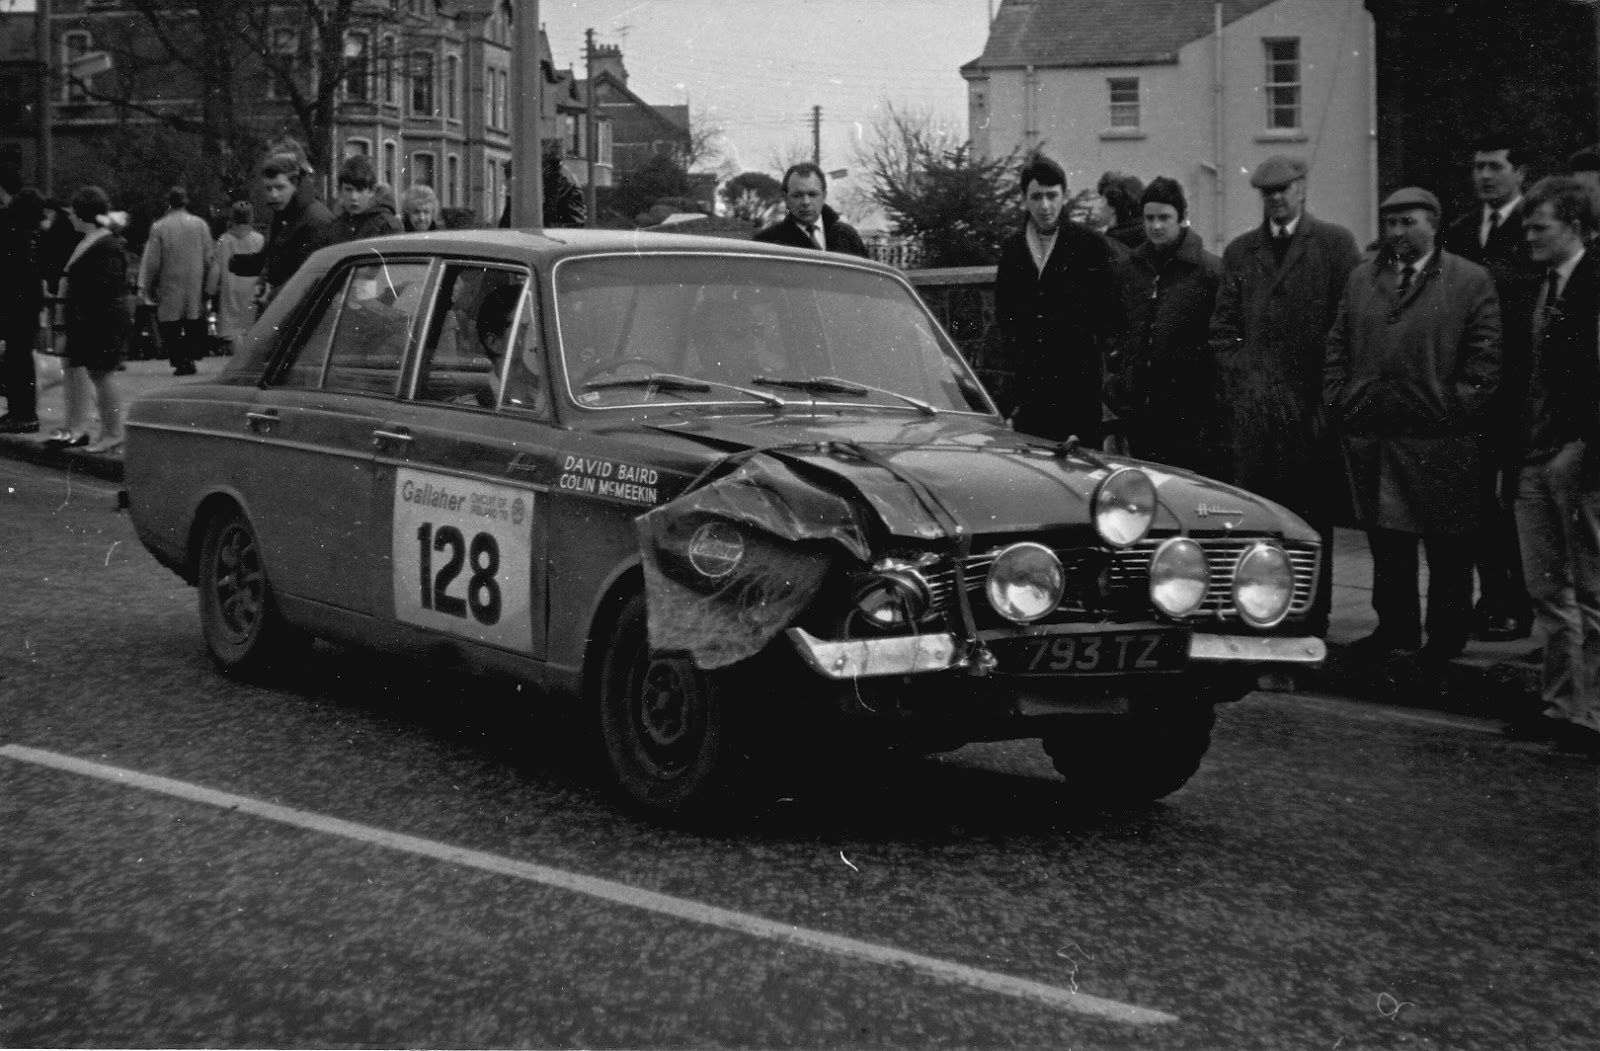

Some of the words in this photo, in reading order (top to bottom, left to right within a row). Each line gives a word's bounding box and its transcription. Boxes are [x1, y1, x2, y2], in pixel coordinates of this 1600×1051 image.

[560, 473, 595, 492] COLIN
[564, 456, 612, 477] DAVID
[618, 464, 658, 485] BAIRD
[402, 480, 466, 512] Gallaher
[417, 521, 502, 626] 128
[1028, 637, 1102, 670] 793
[1115, 635, 1161, 669] TZ
